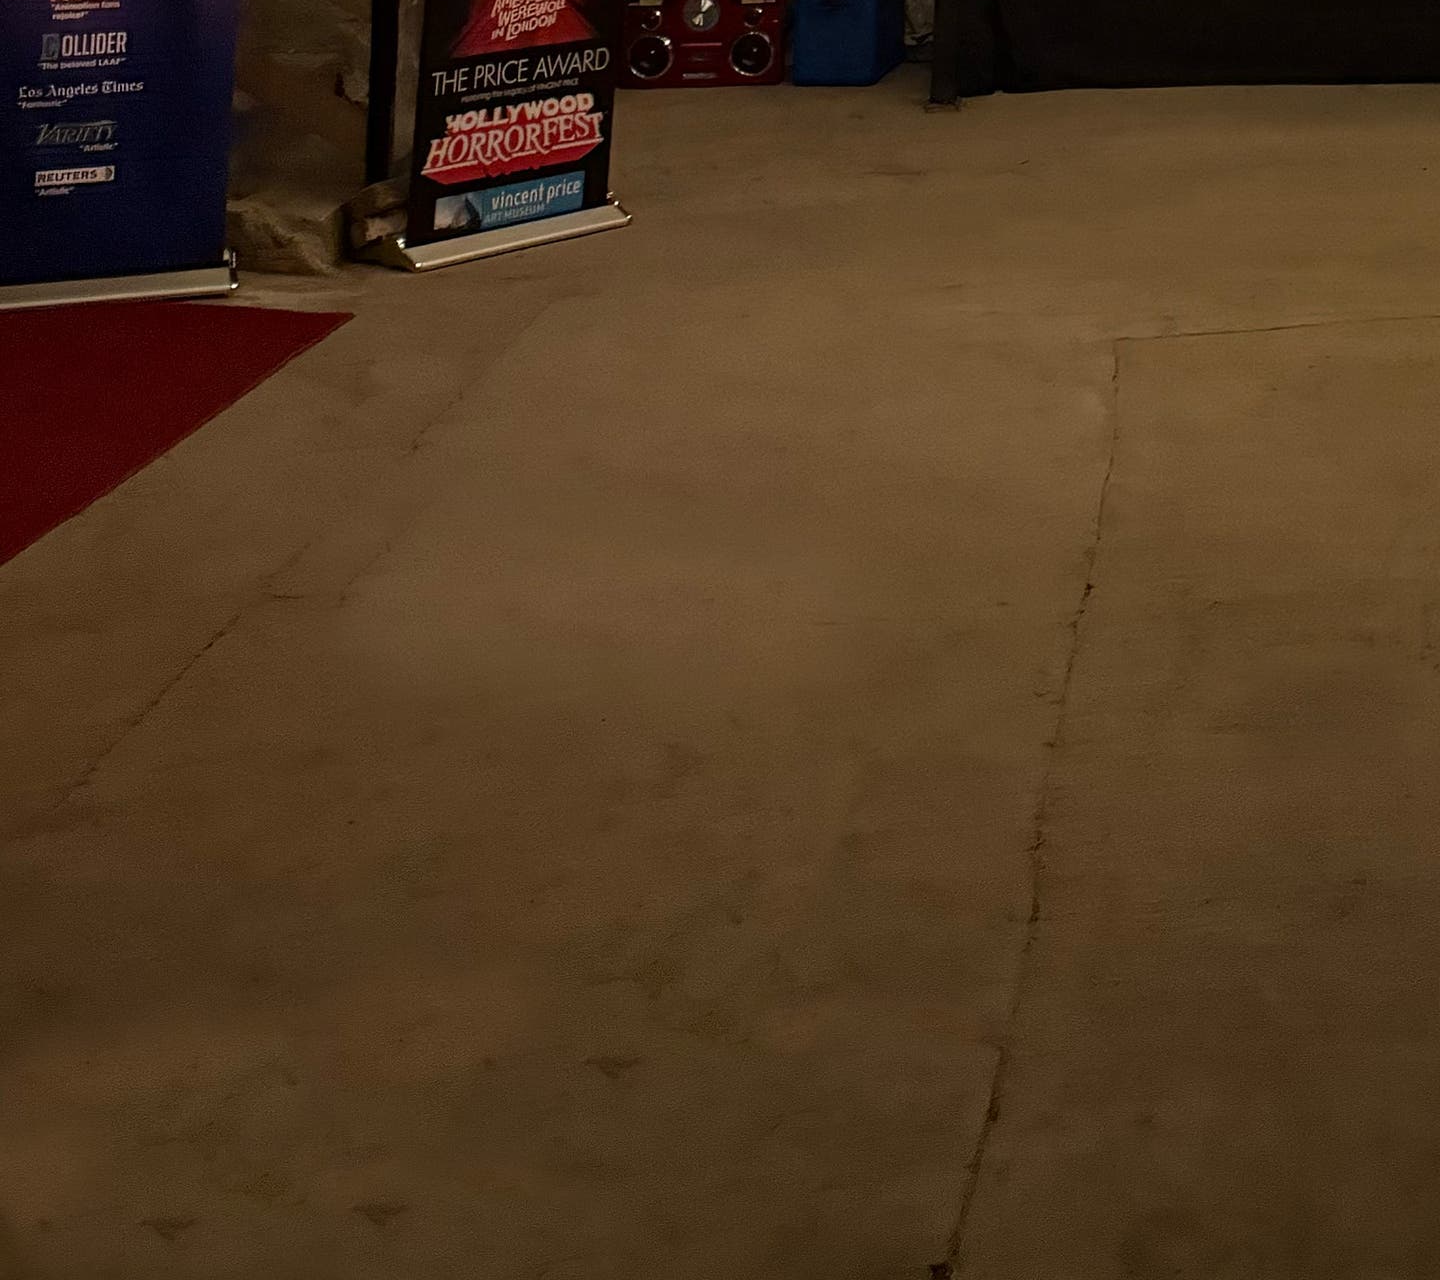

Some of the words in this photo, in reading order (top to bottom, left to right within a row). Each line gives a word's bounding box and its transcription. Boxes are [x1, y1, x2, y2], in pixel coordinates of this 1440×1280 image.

[491, 26, 505, 40] IN
[505, 11, 558, 41] LONDON
[432, 67, 470, 97] THE
[473, 58, 529, 90] PRICE
[532, 47, 610, 81] AWARD
[19, 86, 43, 99] Los
[45, 83, 98, 99] Angeles
[101, 80, 144, 95] Times
[445, 92, 594, 134] HOLLYWOOD
[421, 110, 604, 173] HORRORFEST
[37, 170, 98, 183] REUTERS
[491, 183, 545, 210] vincent
[546, 178, 581, 204] price
